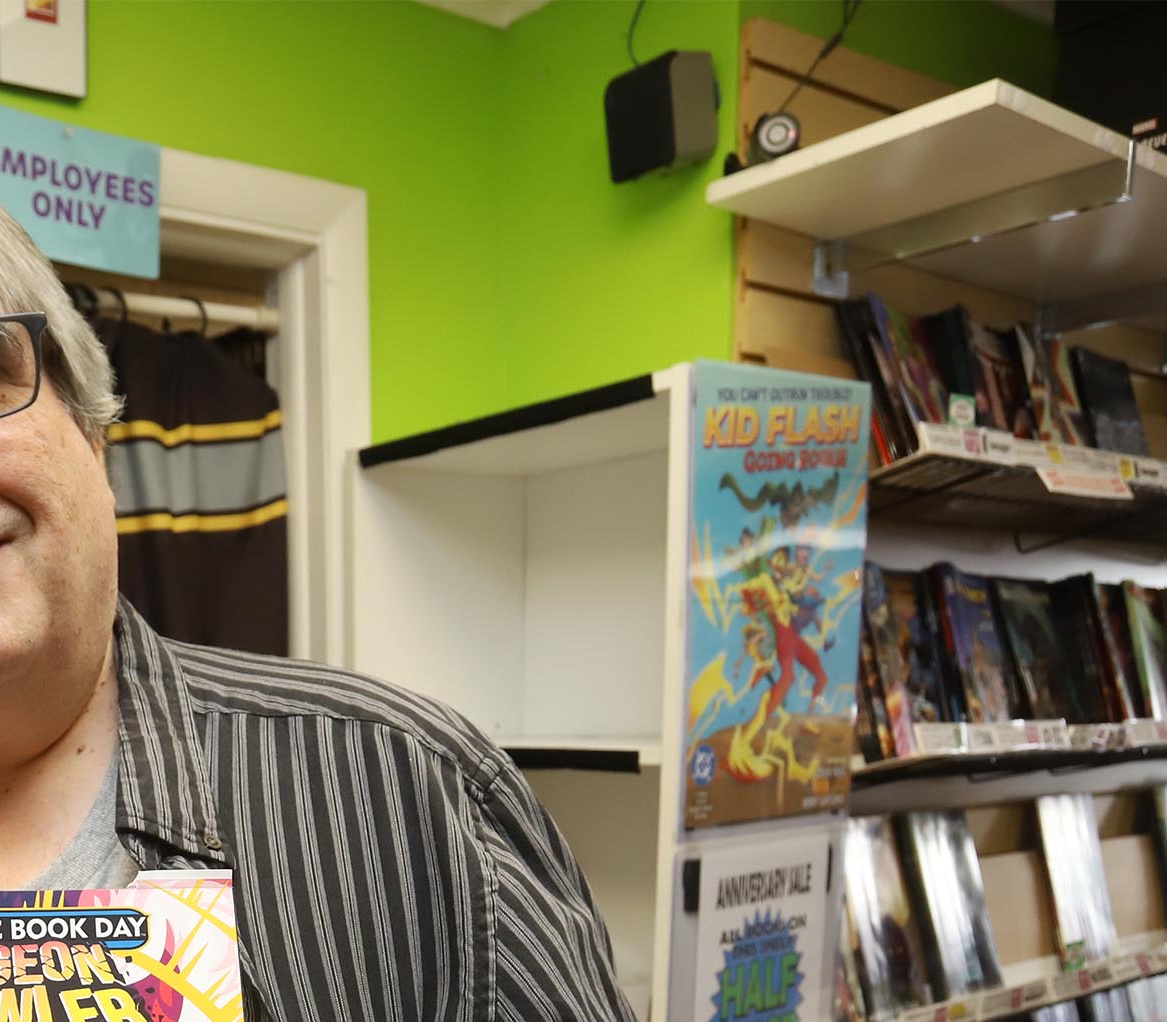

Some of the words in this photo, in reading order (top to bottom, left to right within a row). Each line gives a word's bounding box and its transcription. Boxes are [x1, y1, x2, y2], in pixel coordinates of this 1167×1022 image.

[33, 191, 106, 231] ONLY
[703, 405, 761, 449] KID
[765, 403, 862, 447] FLASH
[715, 866, 787, 910] ANNIVERSARY
[10, 916, 92, 940] BOOK
[95, 915, 145, 939] DAY
